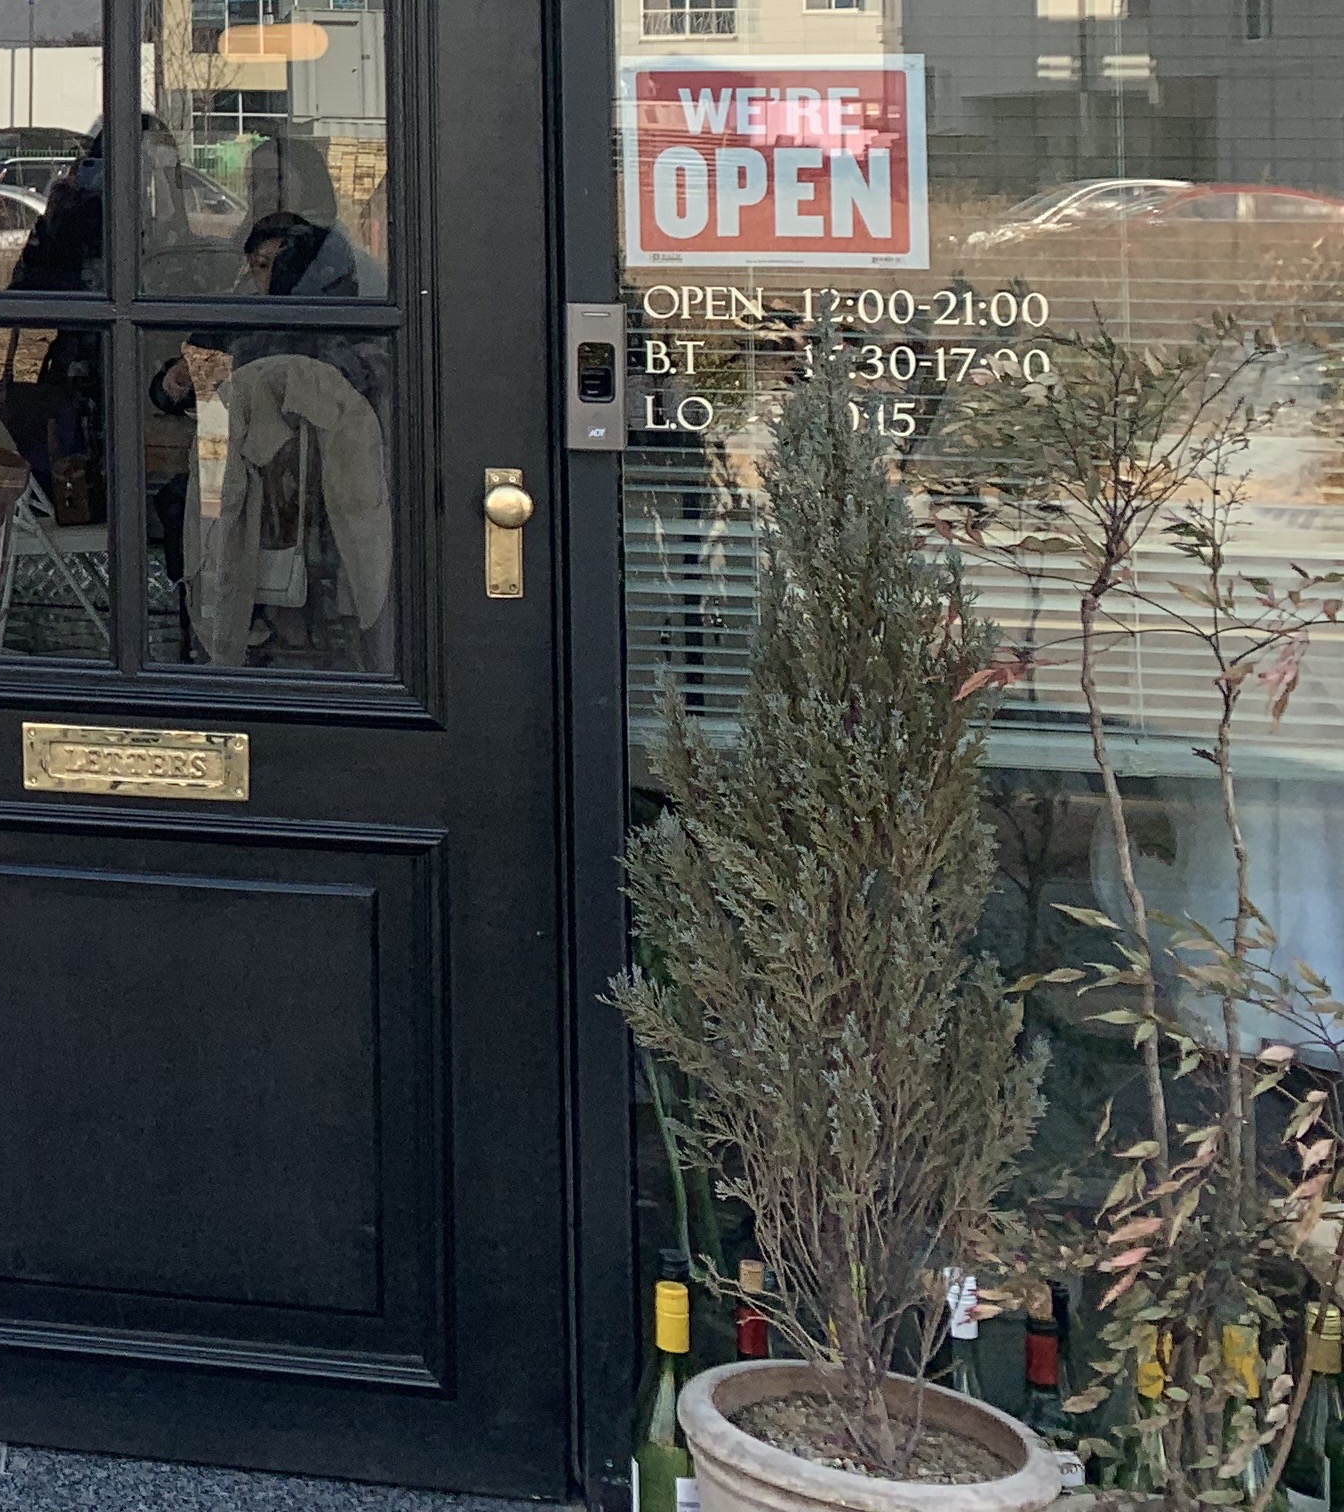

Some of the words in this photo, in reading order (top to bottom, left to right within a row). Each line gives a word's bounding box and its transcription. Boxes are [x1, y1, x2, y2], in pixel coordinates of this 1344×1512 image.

[678, 87, 861, 136] WE'RE
[653, 147, 892, 240] OPEN
[643, 285, 765, 321] OPEN
[802, 287, 1050, 328] 12:00-21:00
[644, 340, 705, 375] B.T
[802, 344, 1051, 384] 1:30-17:00
[644, 394, 714, 431] L.O
[63, 746, 208, 779] LETTERS
